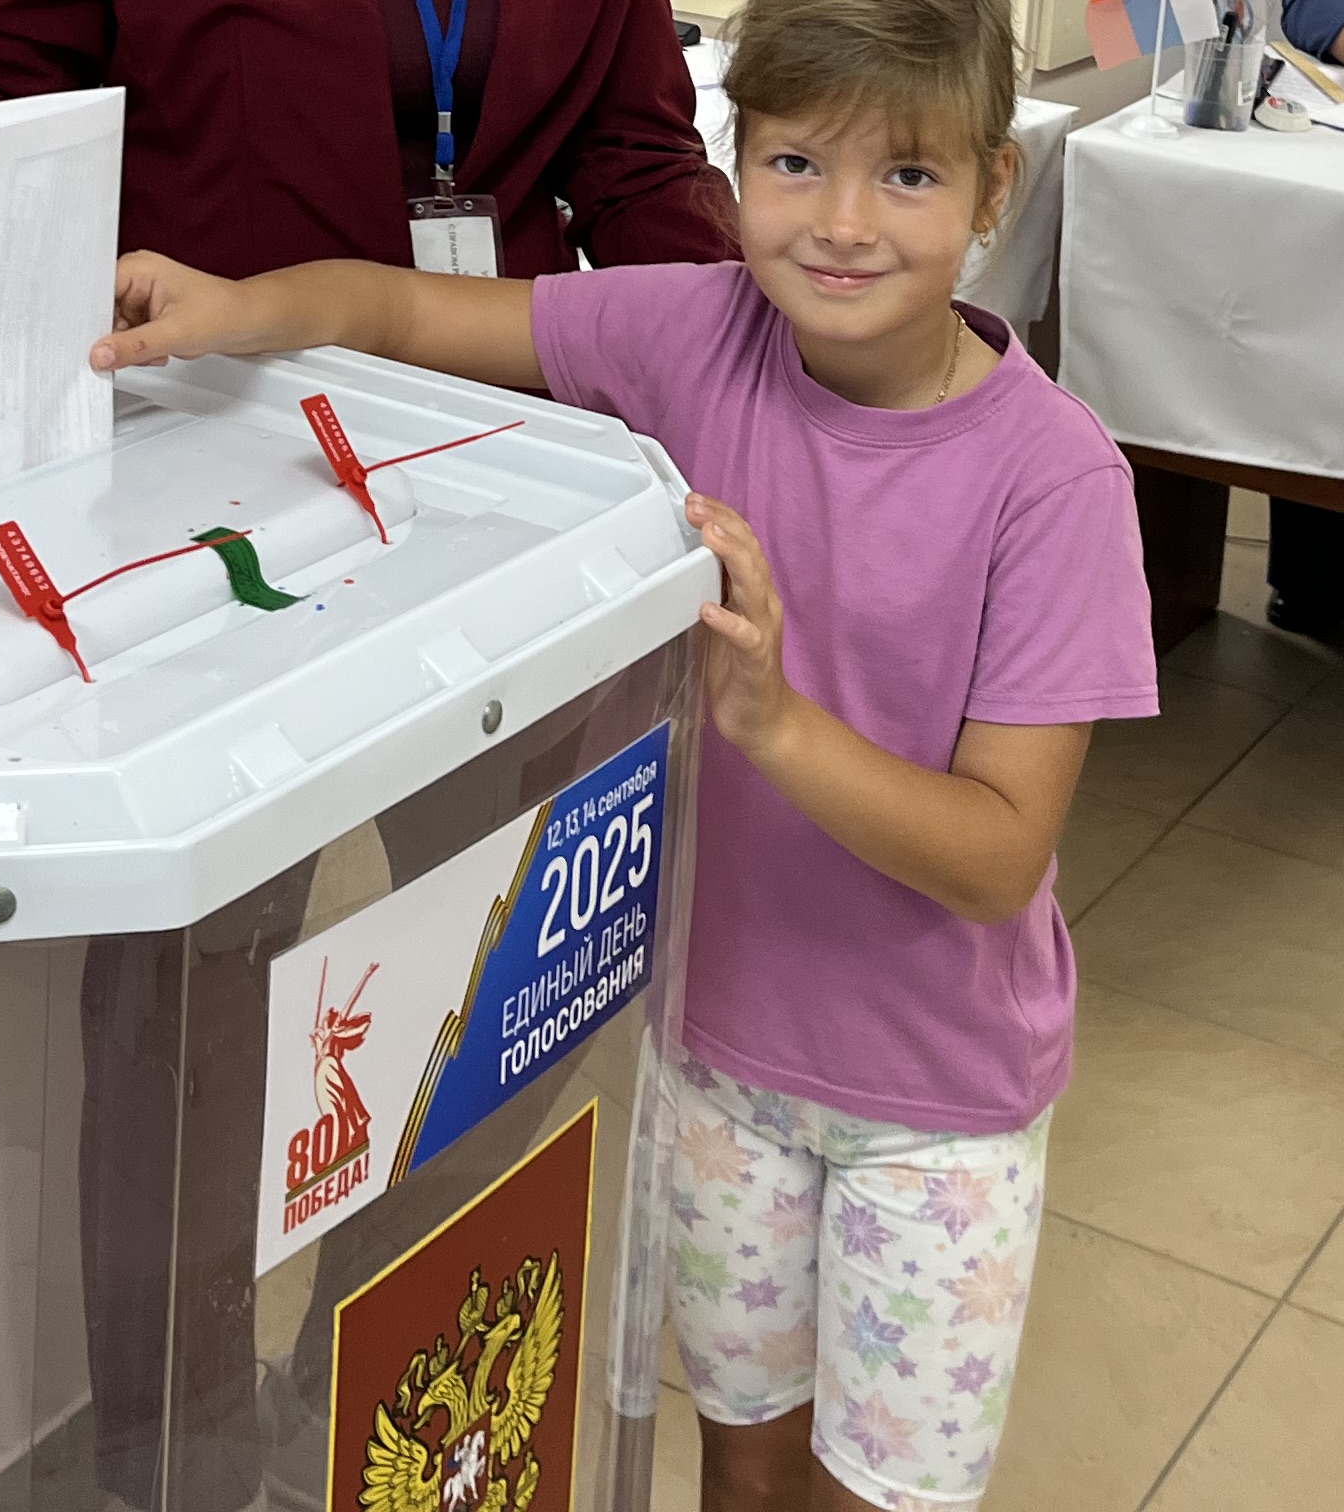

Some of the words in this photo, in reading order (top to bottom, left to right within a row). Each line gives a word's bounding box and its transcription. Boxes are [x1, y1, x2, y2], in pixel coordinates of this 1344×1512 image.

[547, 820, 563, 850] 12,
[565, 808, 580, 838] 13,
[583, 797, 596, 827] 14
[598, 761, 657, 816] сентября
[538, 793, 653, 958] 2025
[502, 933, 593, 1038] ЕДИНЫЙ
[597, 902, 646, 974] ДЕНЬ
[283, 1153, 369, 1234] ПОБЕДА!
[287, 1113, 333, 1191] 80
